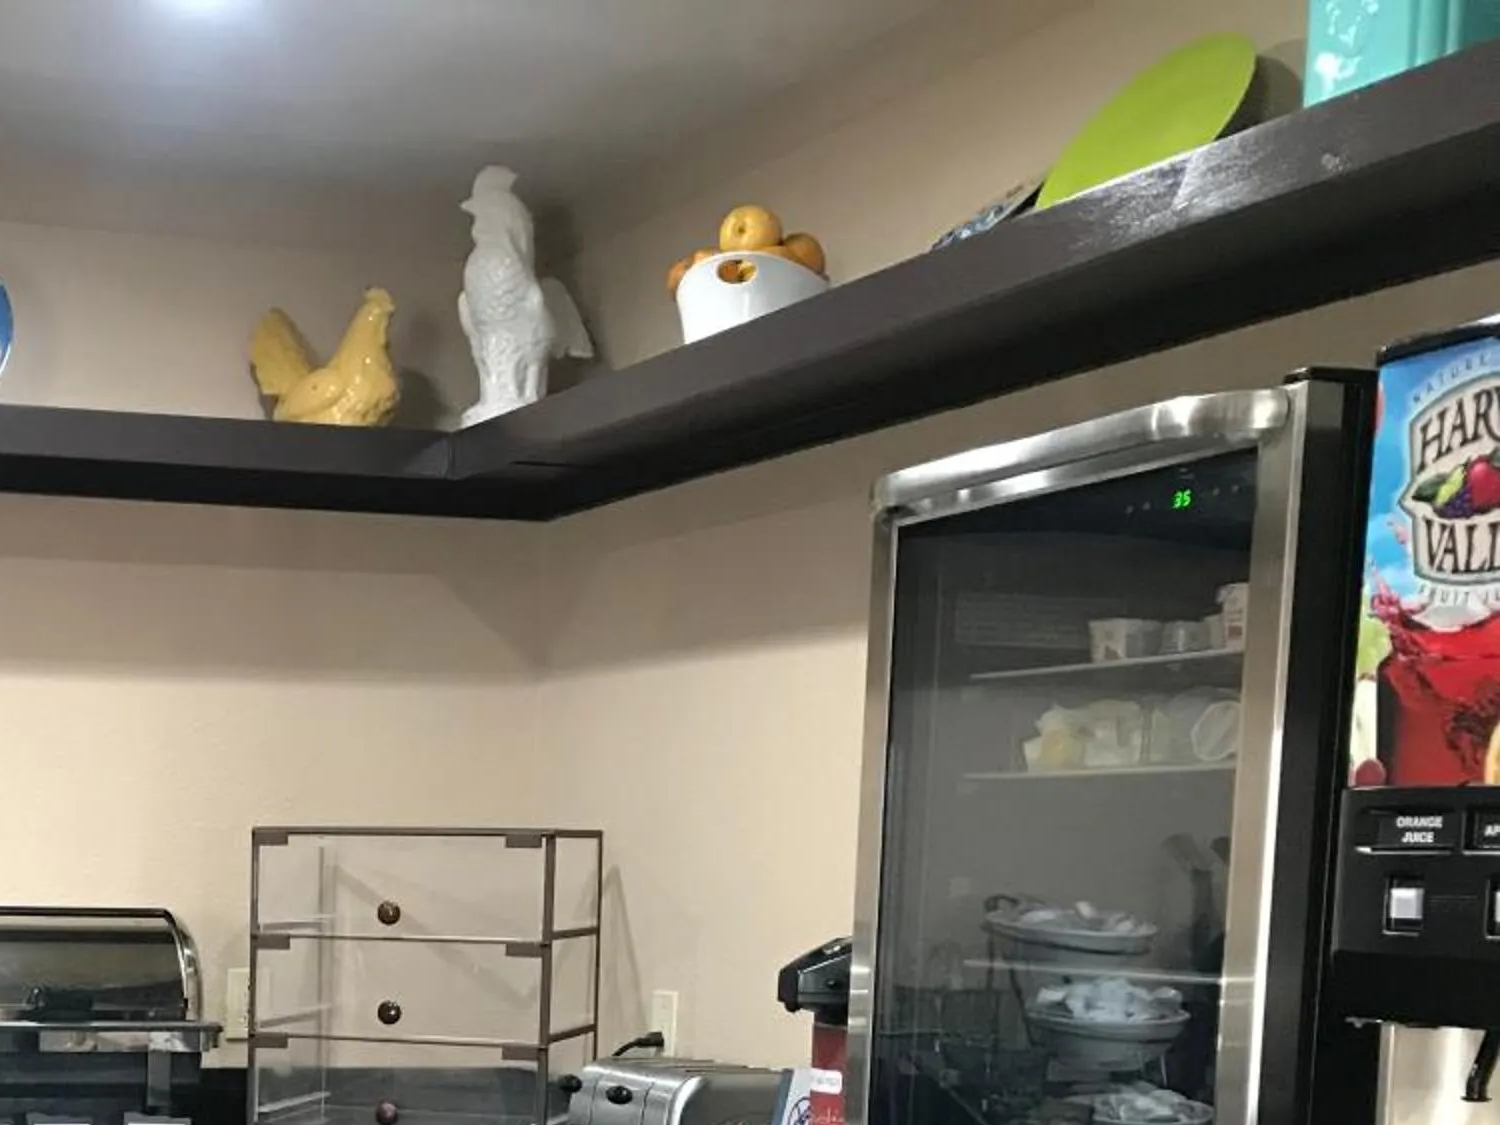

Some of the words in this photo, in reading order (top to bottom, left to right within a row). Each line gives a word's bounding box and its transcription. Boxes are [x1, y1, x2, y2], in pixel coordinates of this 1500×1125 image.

[1416, 386, 1500, 475] HAR
[1172, 488, 1191, 509] 35
[1396, 815, 1443, 828] ORANGE
[1401, 831, 1435, 843] JUICE
